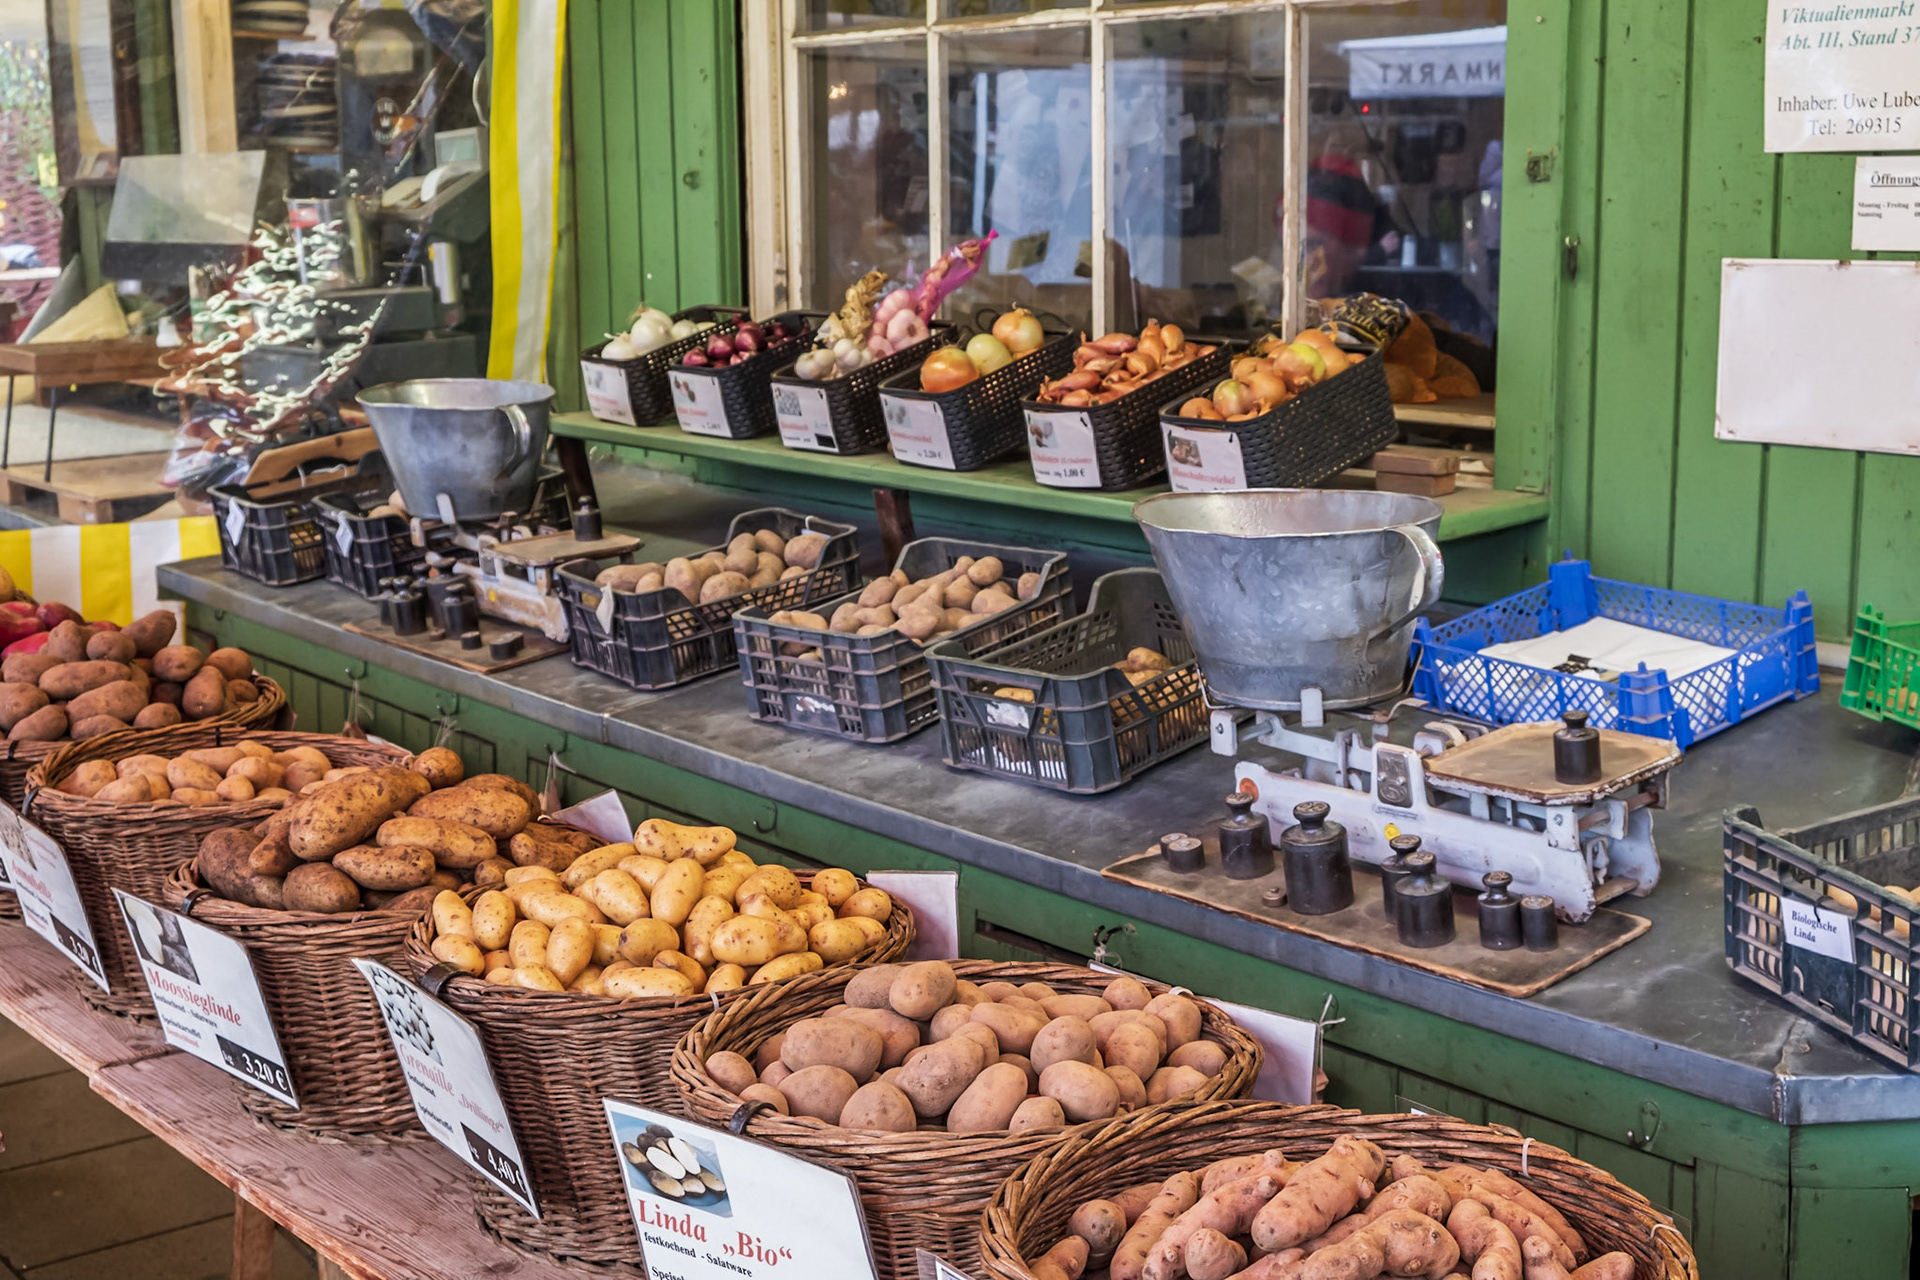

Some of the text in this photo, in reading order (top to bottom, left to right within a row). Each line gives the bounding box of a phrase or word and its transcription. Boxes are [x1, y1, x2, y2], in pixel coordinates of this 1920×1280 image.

[1781, 0, 1915, 24] Viktualienmarkt
[1780, 34, 1811, 50] Abt.
[1849, 28, 1898, 47] Stand
[1777, 95, 1837, 112] Inhaber:
[1843, 93, 1878, 110] Uwe
[1809, 117, 1902, 136] Tel: 269315
[1793, 926, 1816, 943] Linda
[147, 967, 243, 1027] Moossieglinde
[242, 1052, 275, 1085] 3,20
[276, 1068, 288, 1092] €
[400, 1043, 455, 1097] Grenaille
[487, 1148, 516, 1186] 4,40
[637, 1198, 793, 1267] Linda „Bio“
[644, 1230, 696, 1258] festkochend
